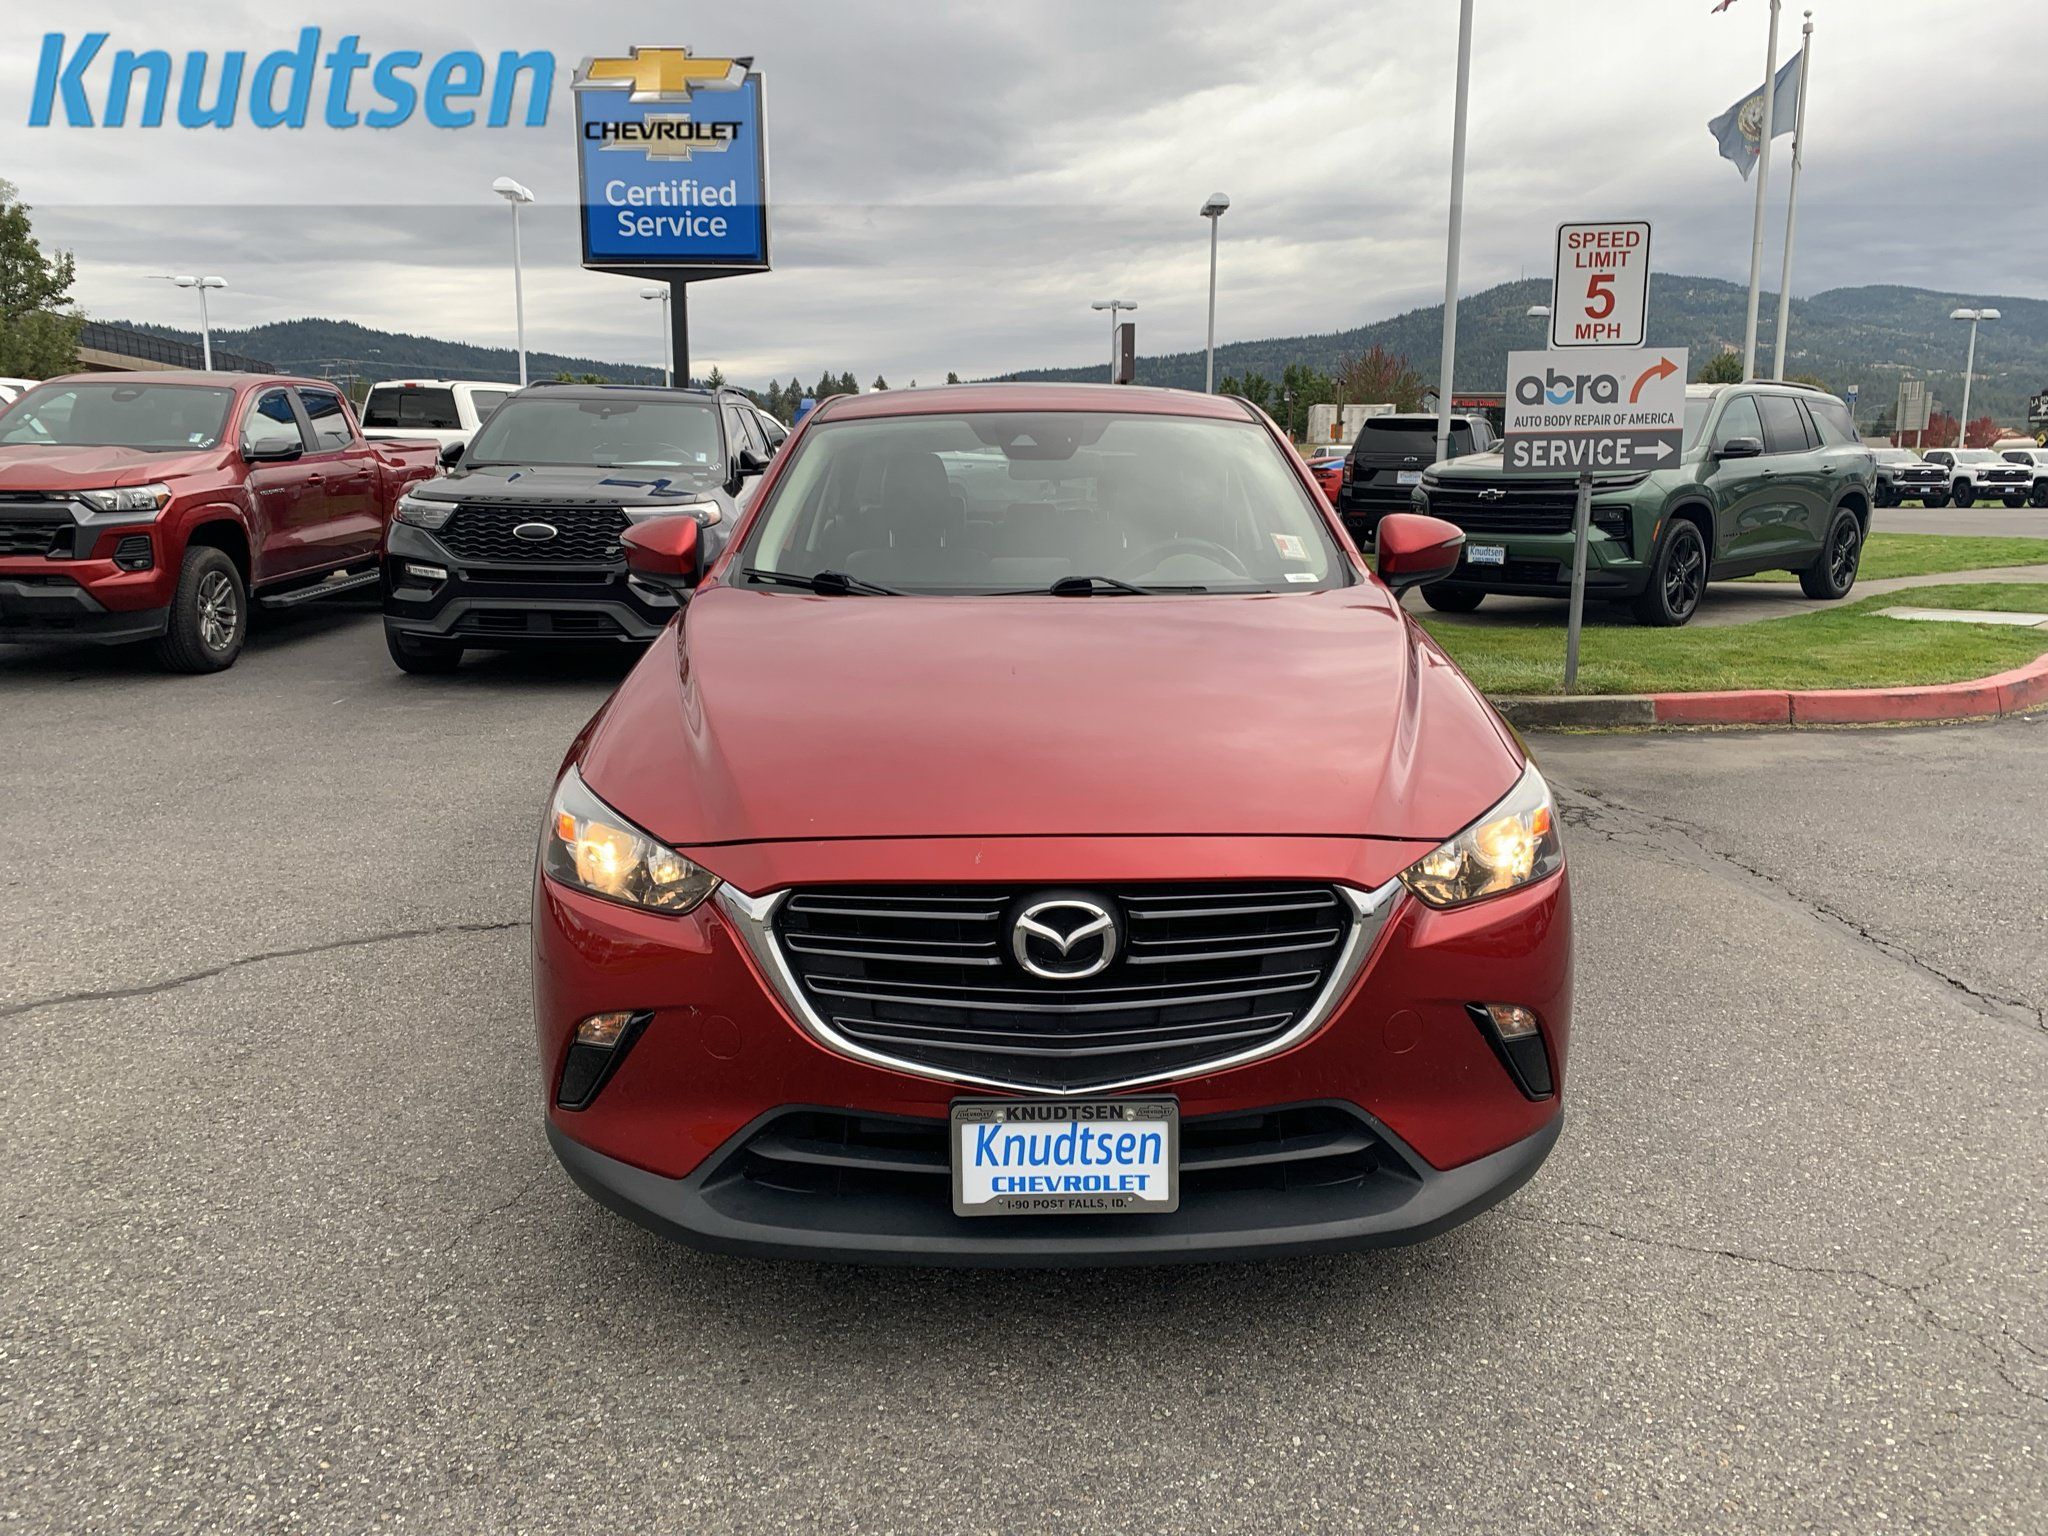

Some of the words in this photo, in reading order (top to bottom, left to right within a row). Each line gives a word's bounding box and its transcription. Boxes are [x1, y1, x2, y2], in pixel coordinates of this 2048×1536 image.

[605, 179, 737, 207] Certified
[617, 210, 728, 237] Service
[1567, 231, 1640, 249] SPEED
[1575, 251, 1631, 268] LIMIT
[1584, 274, 1616, 319] 5
[1575, 323, 1621, 339] MPH
[1515, 368, 1619, 406] abra
[1514, 415, 1542, 427] AUTO
[1544, 414, 1572, 427] BODY
[1574, 413, 1611, 426] REPAIR
[1613, 413, 1628, 425] OF
[1628, 412, 1675, 425] AMERICA
[1513, 438, 1632, 468] SERVICE
[1006, 1105, 1124, 1121] KNUDTSEN
[975, 1122, 1162, 1167] Knudtsen
[992, 1175, 1150, 1192] CHEVROLET
[1007, 1200, 1029, 1209] I-90
[1033, 1199, 1064, 1209] POST
[1068, 1198, 1108, 1209] FALLS,
[1111, 1198, 1127, 1208] ID.
